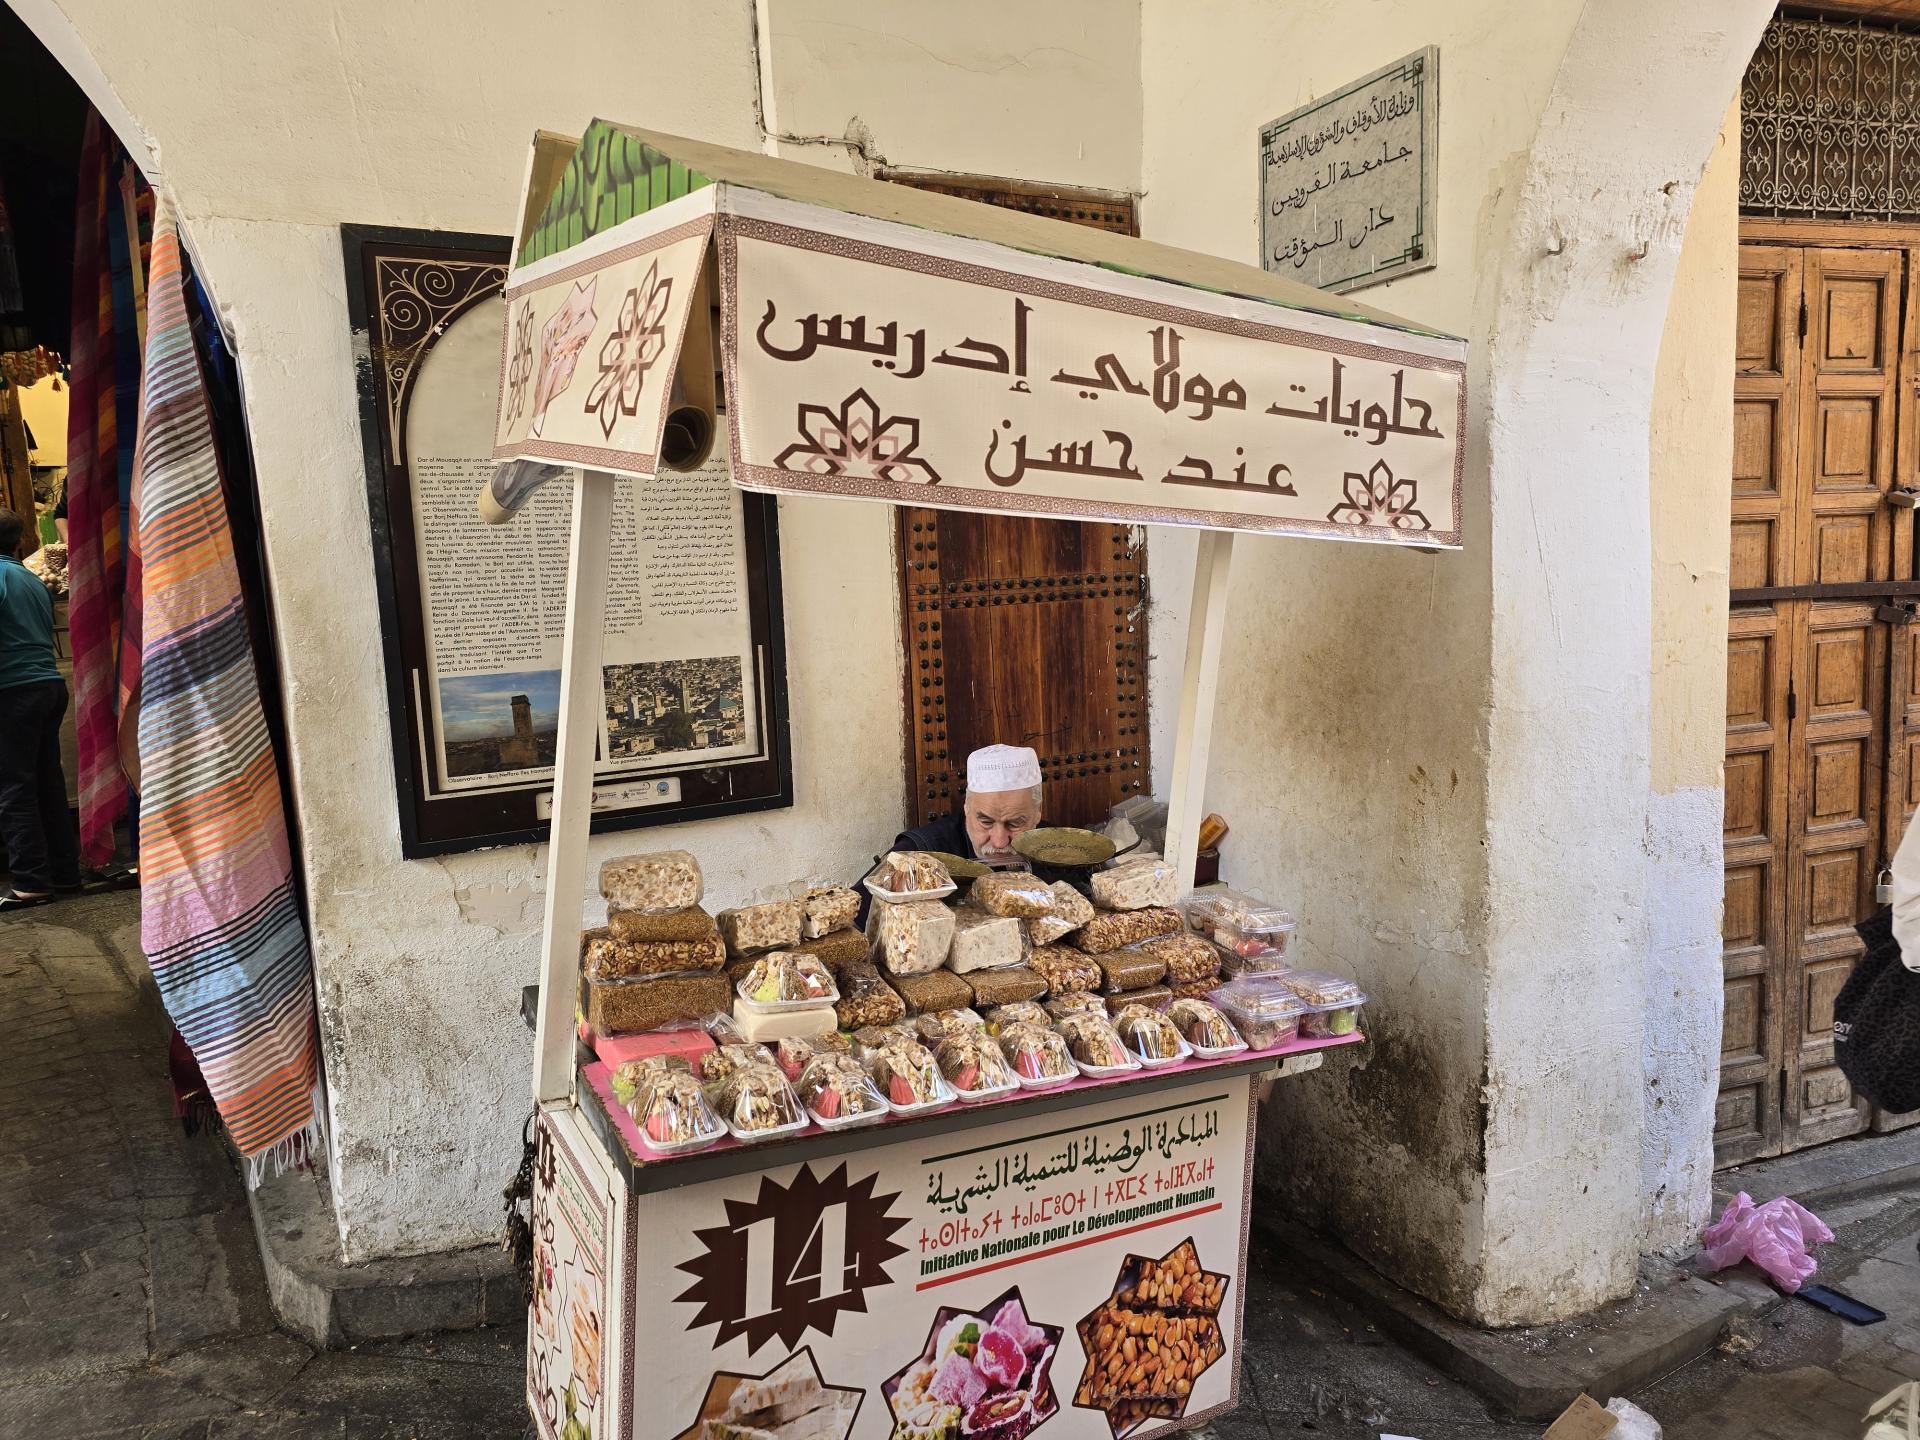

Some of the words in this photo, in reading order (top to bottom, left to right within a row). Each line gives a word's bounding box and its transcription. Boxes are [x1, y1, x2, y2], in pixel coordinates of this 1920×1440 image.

[1272, 162, 1336, 216] القرويين
[1339, 142, 1413, 180] جامعة
[1274, 218, 1343, 269] المؤقت
[1349, 202, 1394, 249] دار
[756, 297, 1032, 396] إدريس
[1050, 325, 1247, 420] مولاي
[1266, 356, 1445, 444] حلويات
[986, 419, 1144, 488] حسن
[1161, 440, 1299, 497] عند
[1082, 1125, 1152, 1174] الوطنية
[1156, 1110, 1218, 1159] المبادرة
[926, 1156, 1008, 1214] البشرية
[1012, 1140, 1078, 1192] للتنمية
[920, 1249, 978, 1276] Initiative
[981, 1231, 1040, 1260] Nationale
[1042, 1225, 1070, 1245] pour
[1073, 1220, 1084, 1235] Le
[1087, 1197, 1173, 1232] Développement
[1176, 1186, 1215, 1208] Humain
[732, 1202, 861, 1324] 14
